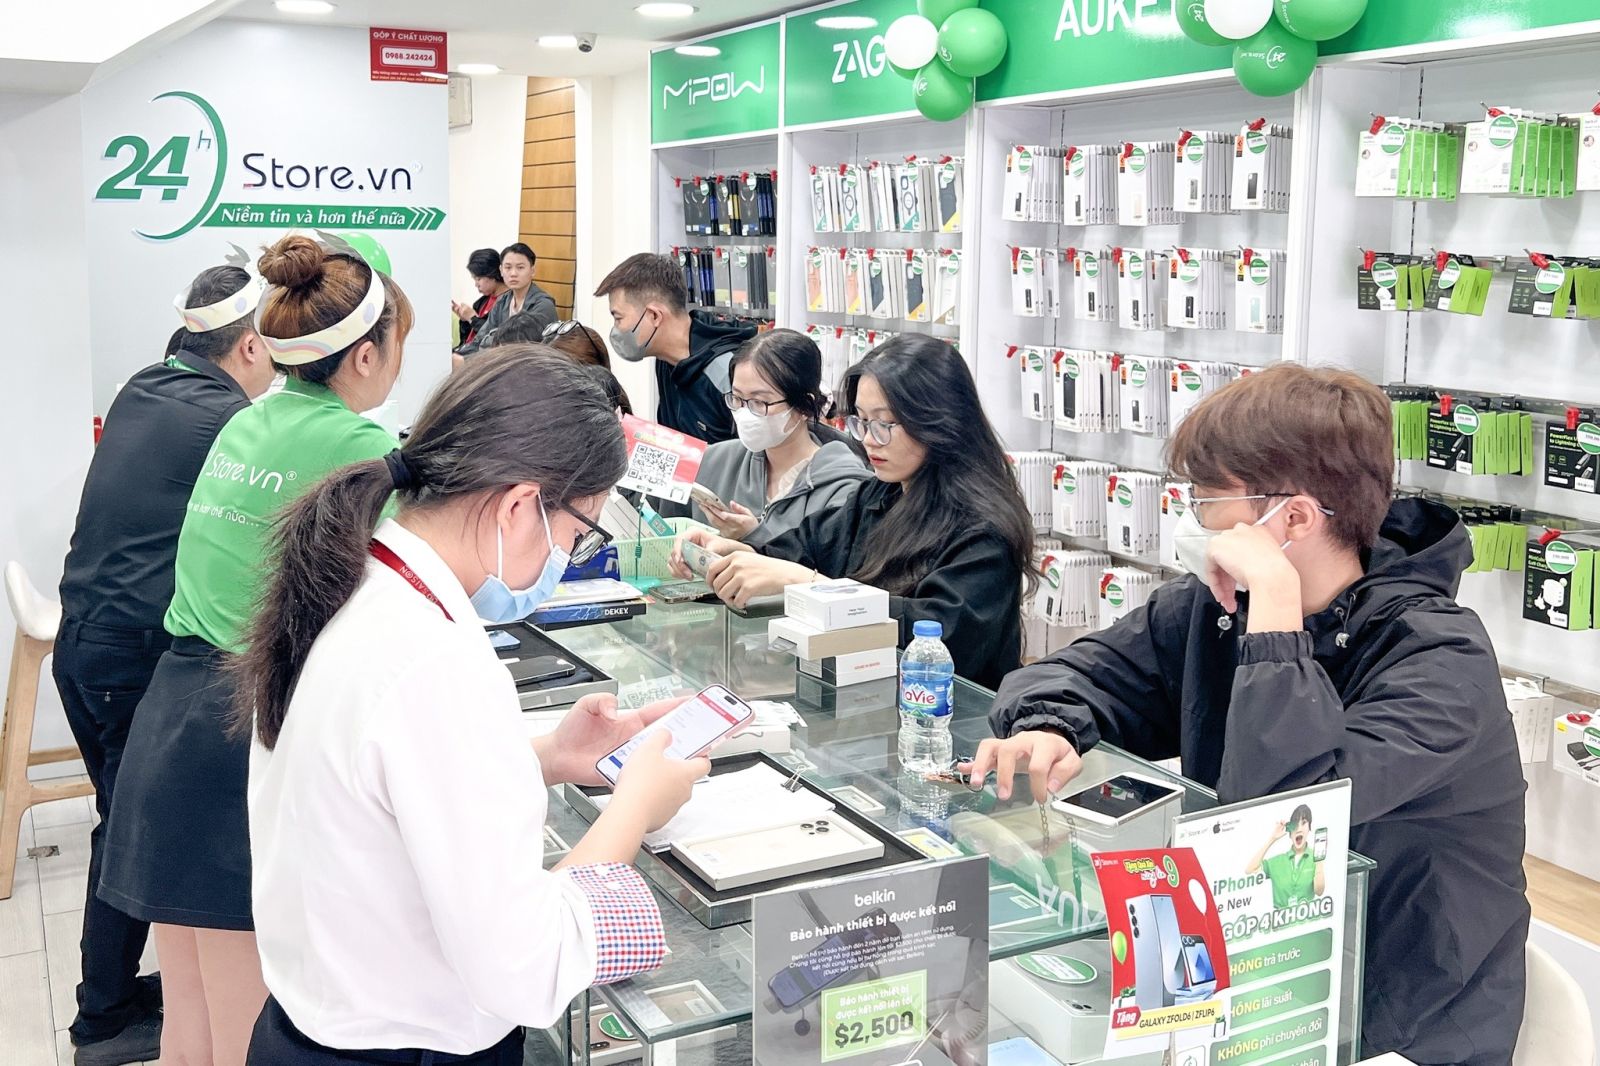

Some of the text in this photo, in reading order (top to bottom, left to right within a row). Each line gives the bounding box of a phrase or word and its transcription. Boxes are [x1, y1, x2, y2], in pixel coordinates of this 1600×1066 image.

[1053, 0, 1175, 41] AUKE
[373, 30, 390, 39] GÓP
[832, 34, 886, 84] ZAG
[221, 205, 406, 225] Niềm tin và hơn thế nữa
[1213, 872, 1264, 897] iPhone
[854, 889, 896, 908] belkin
[1227, 896, 1252, 911] New
[789, 900, 957, 942] Bảo hành thiết bị được kết nối
[1222, 896, 1333, 941] GÓP 4 KHÔNG
[1230, 956, 1263, 977] HÔNG
[1277, 948, 1301, 963] trước
[840, 995, 856, 1007] Bảo
[858, 991, 879, 1003] hành
[1230, 998, 1262, 1018] HÔNG
[834, 1010, 914, 1049] $2,500
[1117, 1007, 1215, 1029] Tặng GALAXY ZFOLD6 ZFLIP6
[1217, 1038, 1260, 1062] KHÔNG
